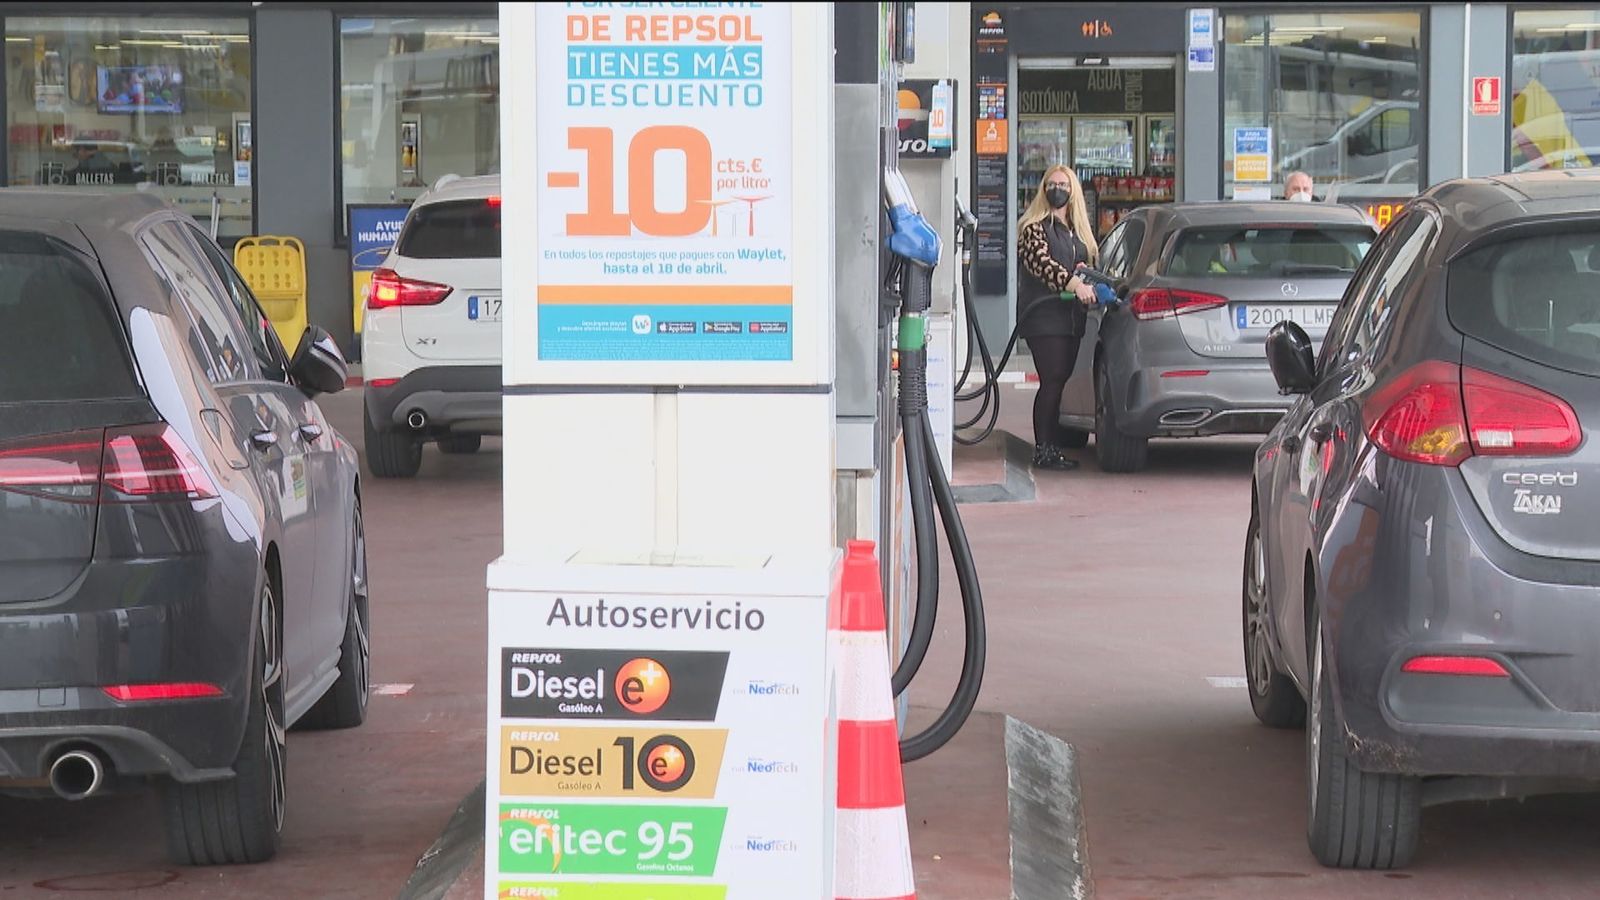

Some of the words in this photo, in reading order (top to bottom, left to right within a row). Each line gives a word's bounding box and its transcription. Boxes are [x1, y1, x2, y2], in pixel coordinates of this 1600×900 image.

[567, 15, 611, 41] DE
[625, 15, 762, 41] REPSOL
[569, 52, 680, 77] TIENES
[693, 46, 760, 77] MÁS
[1087, 68, 1122, 91] AGUA
[567, 83, 763, 107] DESCUENTO
[1018, 87, 1080, 113] ISOTÓNICA
[547, 125, 713, 237] -10
[717, 178, 737, 192] por
[544, 249, 557, 260] En
[559, 249, 586, 260] todos
[588, 249, 603, 260] los
[606, 250, 657, 262] repostajes
[659, 250, 677, 262] que
[679, 250, 715, 262] pagues
[717, 251, 735, 260] con
[738, 248, 786, 261] Waylet,
[603, 262, 639, 274] hasta
[642, 262, 654, 274] el
[657, 263, 673, 274] 18
[677, 262, 692, 274] de
[695, 262, 728, 274] abril.
[1251, 308, 1295, 325] 2001
[416, 337, 437, 345] X1
[547, 597, 765, 631] Autoservicio
[511, 653, 563, 664] REPSOL
[510, 667, 604, 699] Diesel
[558, 702, 593, 713] Gasóleo
[595, 703, 603, 713] A
[510, 731, 561, 743] REPSOL
[510, 746, 602, 776] Diesel
[557, 781, 593, 792] Gasóleo
[594, 781, 602, 791] A
[510, 808, 561, 820] REPSOL
[509, 823, 627, 855] efitec
[637, 821, 694, 861] 95
[636, 863, 665, 872] Gasolina
[509, 886, 559, 898] REPSOL
